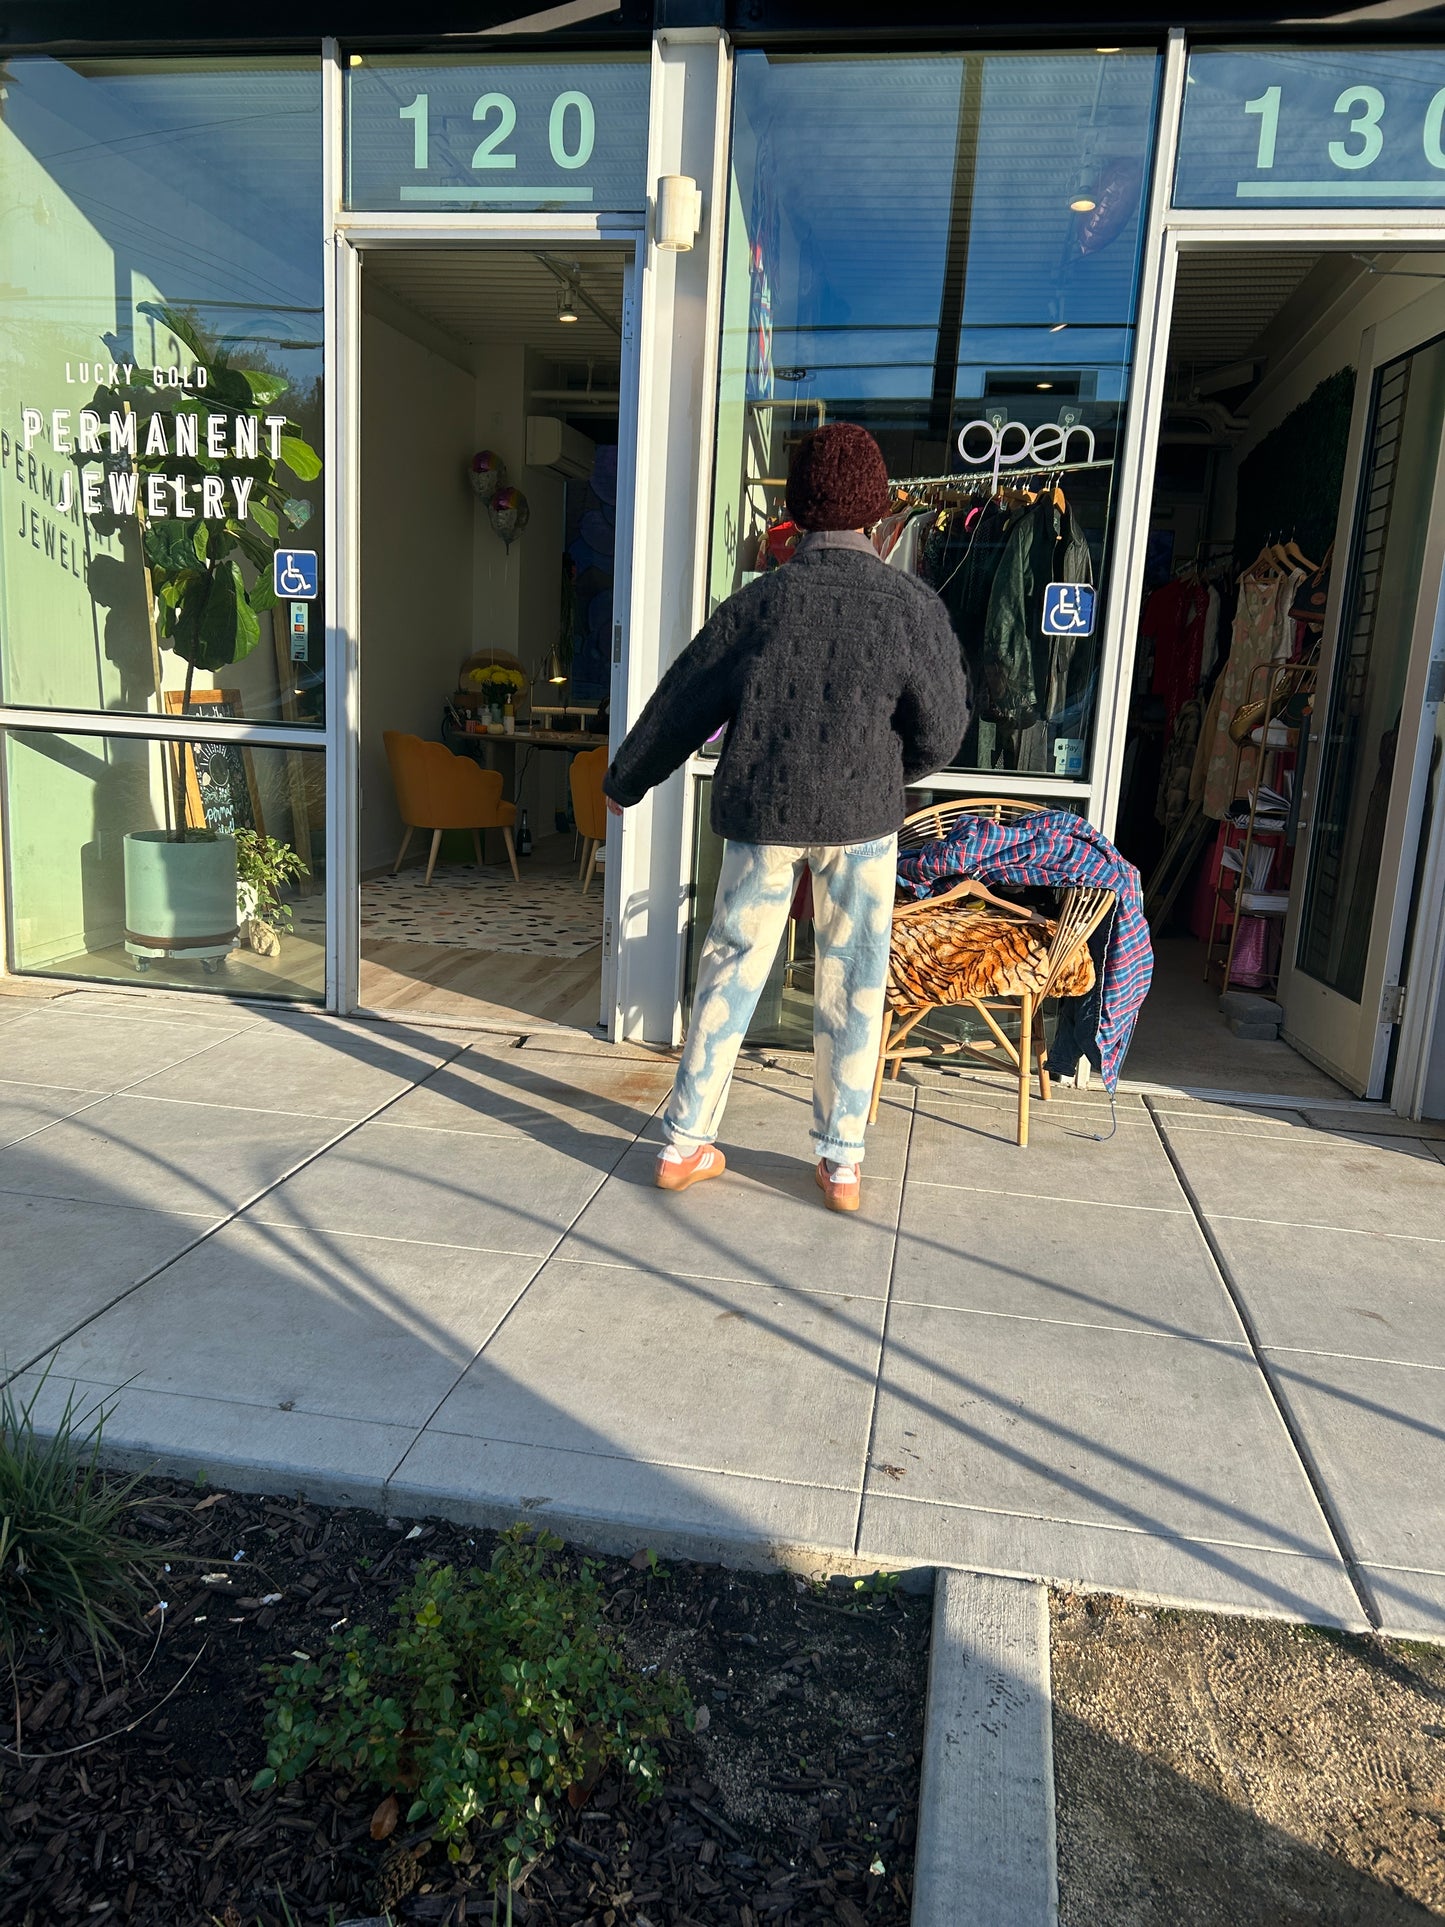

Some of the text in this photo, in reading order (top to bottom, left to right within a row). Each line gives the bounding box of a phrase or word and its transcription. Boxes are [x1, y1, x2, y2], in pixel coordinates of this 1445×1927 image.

[399, 90, 596, 170] 120
[65, 362, 208, 388] LUCKY GOLD
[23, 407, 287, 460] PERMANENT
[957, 420, 1095, 495] open
[54, 470, 254, 520] JEWELRY
